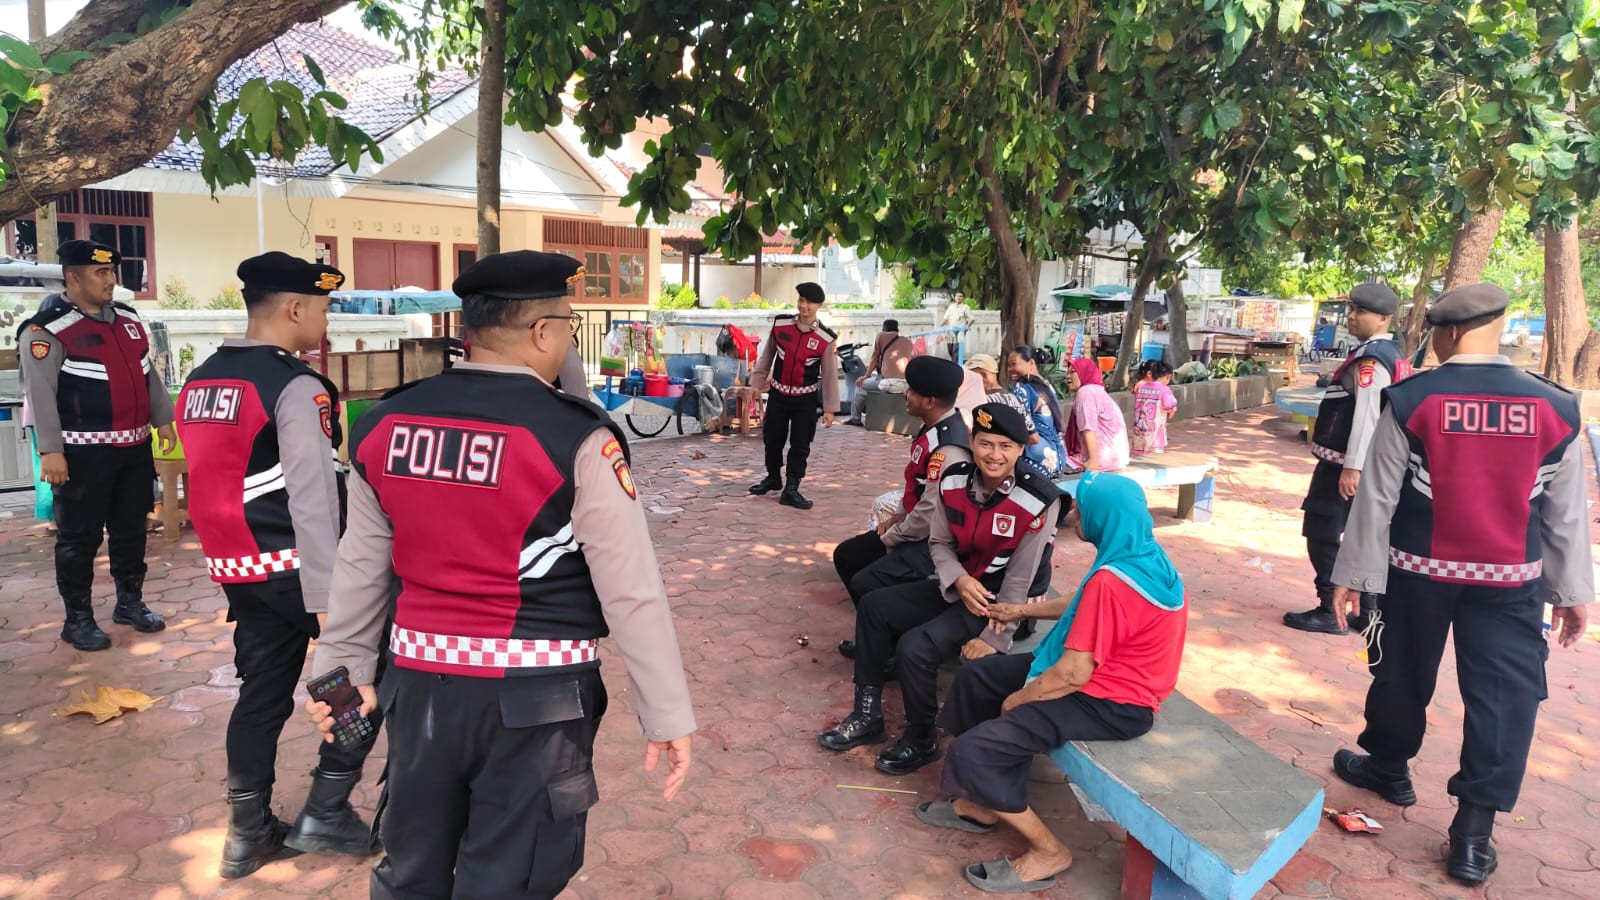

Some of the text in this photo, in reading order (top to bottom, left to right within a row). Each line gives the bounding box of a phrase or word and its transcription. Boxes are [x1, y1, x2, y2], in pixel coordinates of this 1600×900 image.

[184, 387, 239, 420] POLISI
[1444, 401, 1536, 434] POLISI
[386, 426, 506, 484] POLISI
